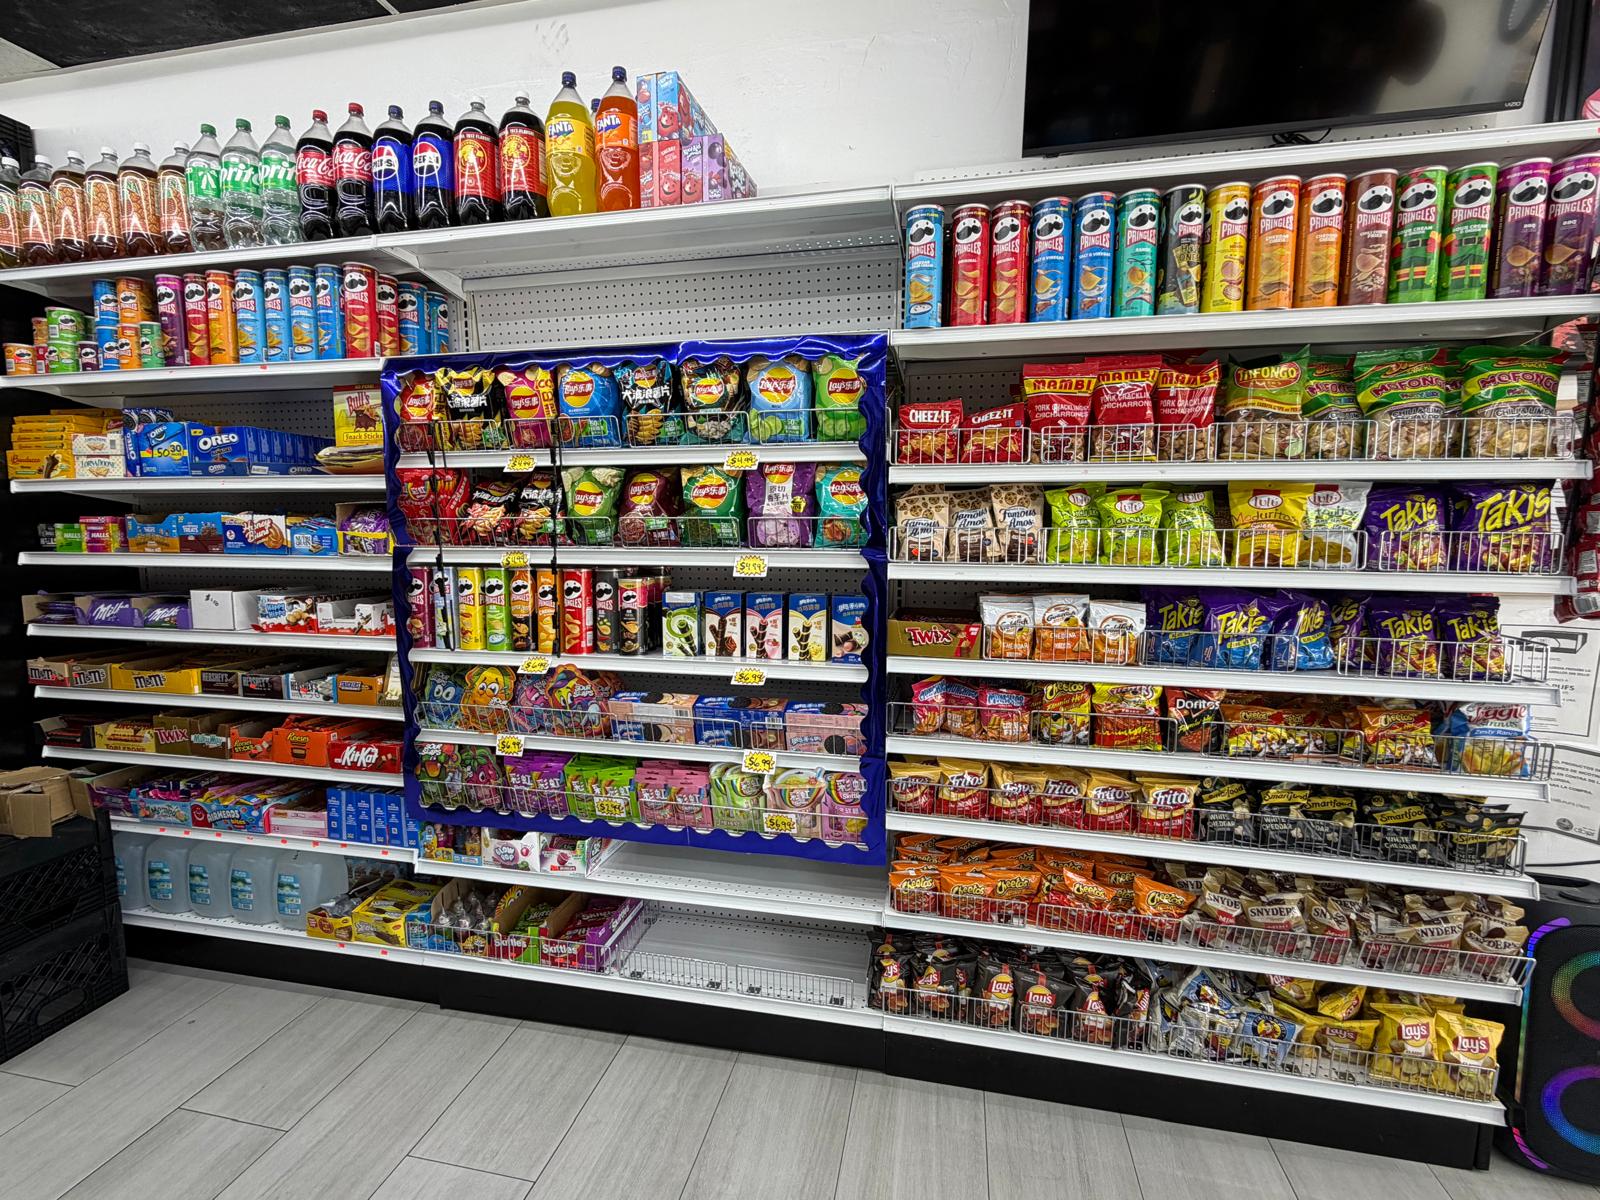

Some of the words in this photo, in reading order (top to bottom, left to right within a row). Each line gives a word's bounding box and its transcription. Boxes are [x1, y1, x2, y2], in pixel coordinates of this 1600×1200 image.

[548, 121, 574, 138] FANTA
[597, 115, 622, 133] FANTA
[1397, 206, 1437, 228] PRINGLES
[1451, 204, 1491, 224] PRINGLES
[1550, 198, 1593, 220] PRINGLES
[1260, 215, 1294, 234] PRINGLES
[1356, 211, 1392, 229] PRINGLES
[1034, 236, 1064, 254] PRINGLES
[1080, 233, 1111, 249] PRINGLES
[1127, 229, 1157, 247] PRINGLES
[908, 241, 937, 258] PRINGLES
[954, 241, 982, 258] PRINGLES
[992, 238, 1021, 258] PRINGLES
[829, 381, 845, 392] Lay's
[1032, 378, 1092, 392] MAMBI
[908, 409, 951, 424] CHEEZ-IT
[971, 407, 1014, 424] CHEEZ-IT
[169, 444, 182, 453] 30
[199, 434, 240, 451] OREO
[290, 466, 313, 474] OREO
[951, 506, 989, 524] Famous
[999, 507, 1037, 523] Famous
[1380, 497, 1438, 540] Takis
[1475, 487, 1551, 538] Takis
[243, 517, 272, 536] Honey
[958, 517, 986, 528] Amos
[1009, 518, 1035, 528] Amos
[91, 531, 110, 539] HALLS
[1159, 601, 1204, 632] Takis
[1217, 607, 1266, 645] Takis
[1381, 612, 1433, 640] Takis
[1447, 615, 1499, 643] Takis
[1045, 682, 1086, 700] Cheetos
[1176, 699, 1220, 711] Doritos
[1380, 712, 1415, 728] Cheetos
[950, 773, 985, 788] Fritos
[1046, 780, 1079, 796] Fritos
[1091, 786, 1131, 803] Fritos
[1152, 788, 1190, 806] Frito
[1304, 798, 1353, 810] Smartfood
[207, 809, 241, 822] AIRHEADS
[1379, 809, 1424, 823] Smartfoo
[901, 877, 934, 894] Cheetos
[952, 883, 985, 897] Cheetos
[996, 878, 1030, 896] Cheetos
[1073, 882, 1105, 898] Cheetos
[1147, 890, 1185, 908] Cheetos
[1416, 924, 1463, 938] SNYDER'S
[542, 943, 577, 955] Skittles
[991, 981, 1014, 994] Lay's
[1027, 993, 1053, 1005] Lay's
[1325, 1026, 1355, 1039] Lay's
[1401, 1022, 1429, 1041] Lay's
[1457, 1036, 1488, 1054] Lay's
